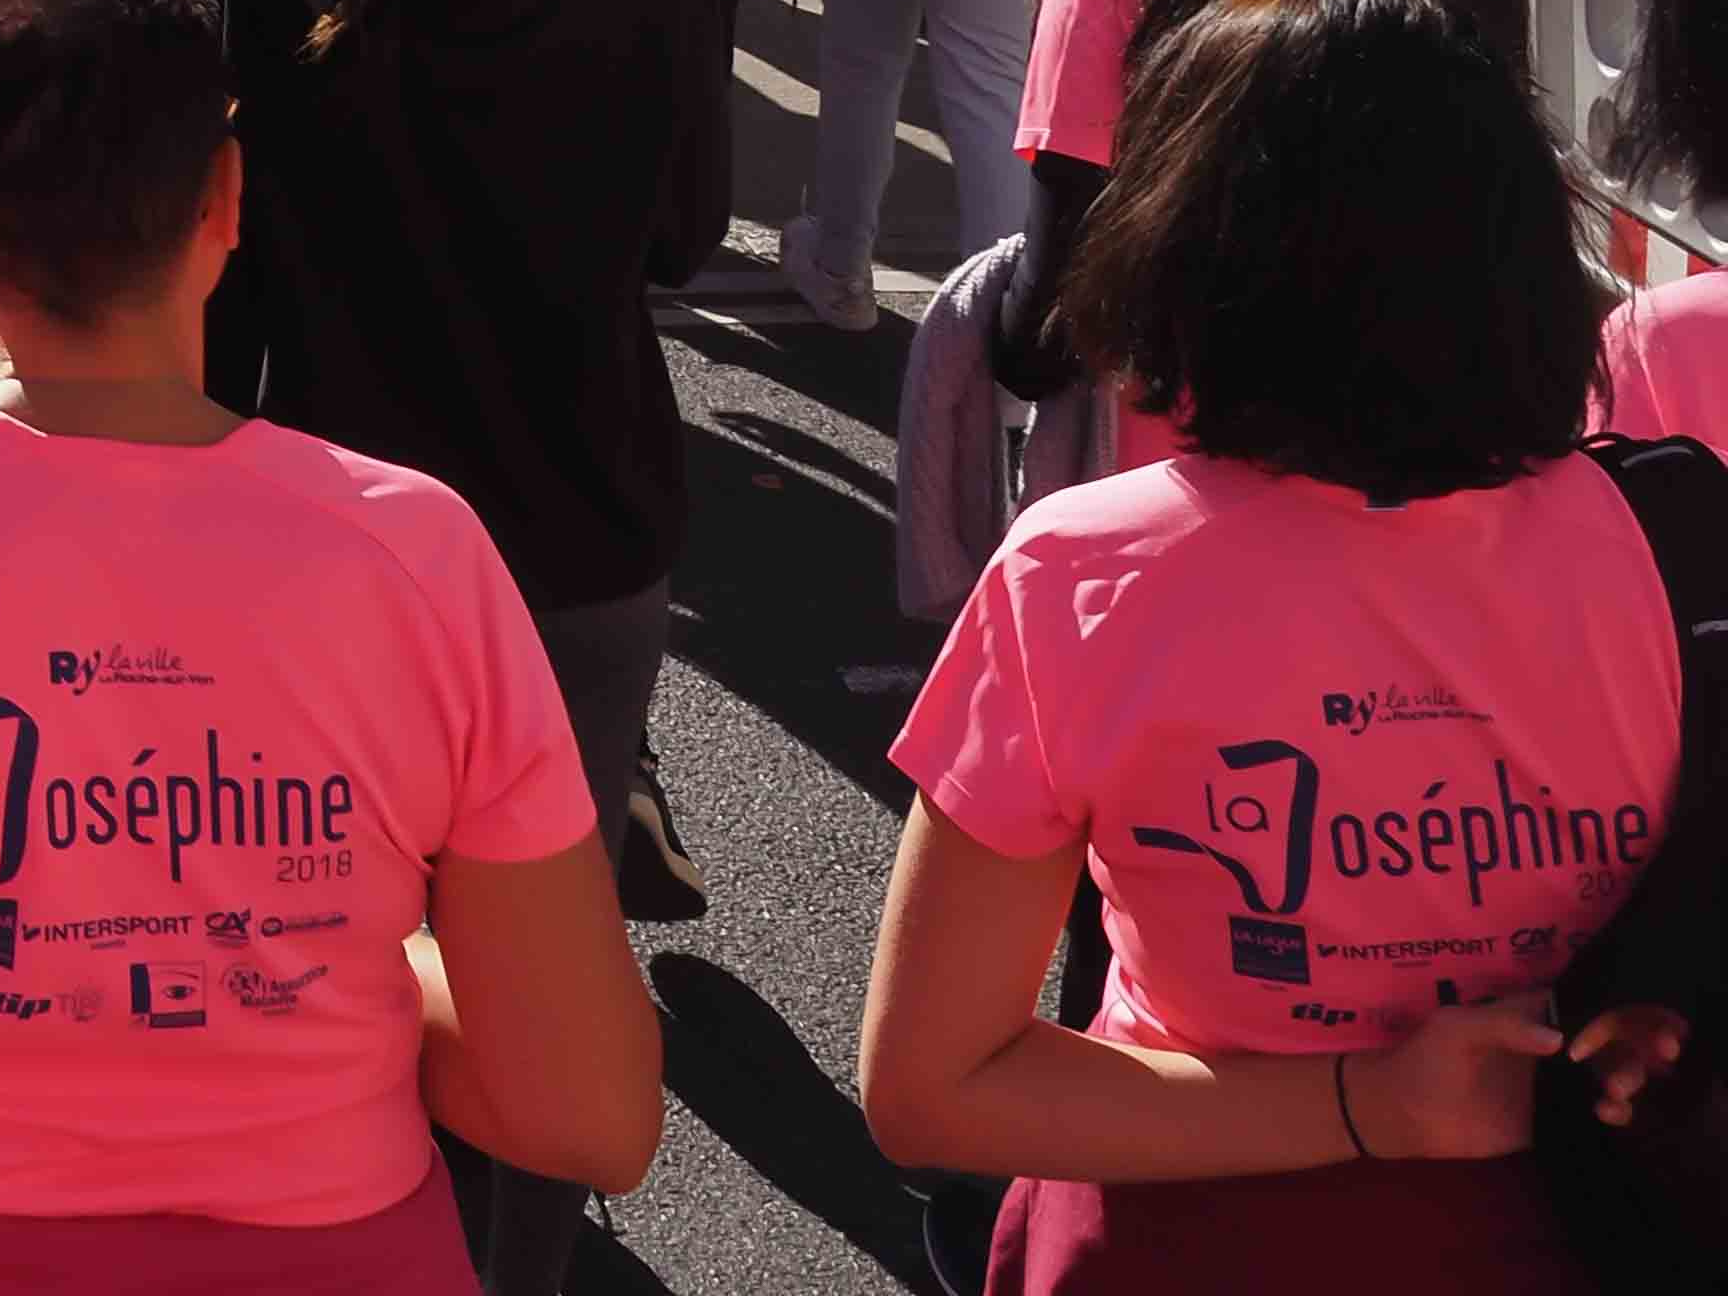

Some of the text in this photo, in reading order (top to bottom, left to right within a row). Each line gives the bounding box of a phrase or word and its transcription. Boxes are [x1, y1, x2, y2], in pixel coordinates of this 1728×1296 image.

[1131, 740, 1649, 913] la Joséphine
[276, 849, 353, 883] 2018
[44, 915, 193, 942] INTERSPORT
[1343, 937, 1496, 960] INTERSPORT
